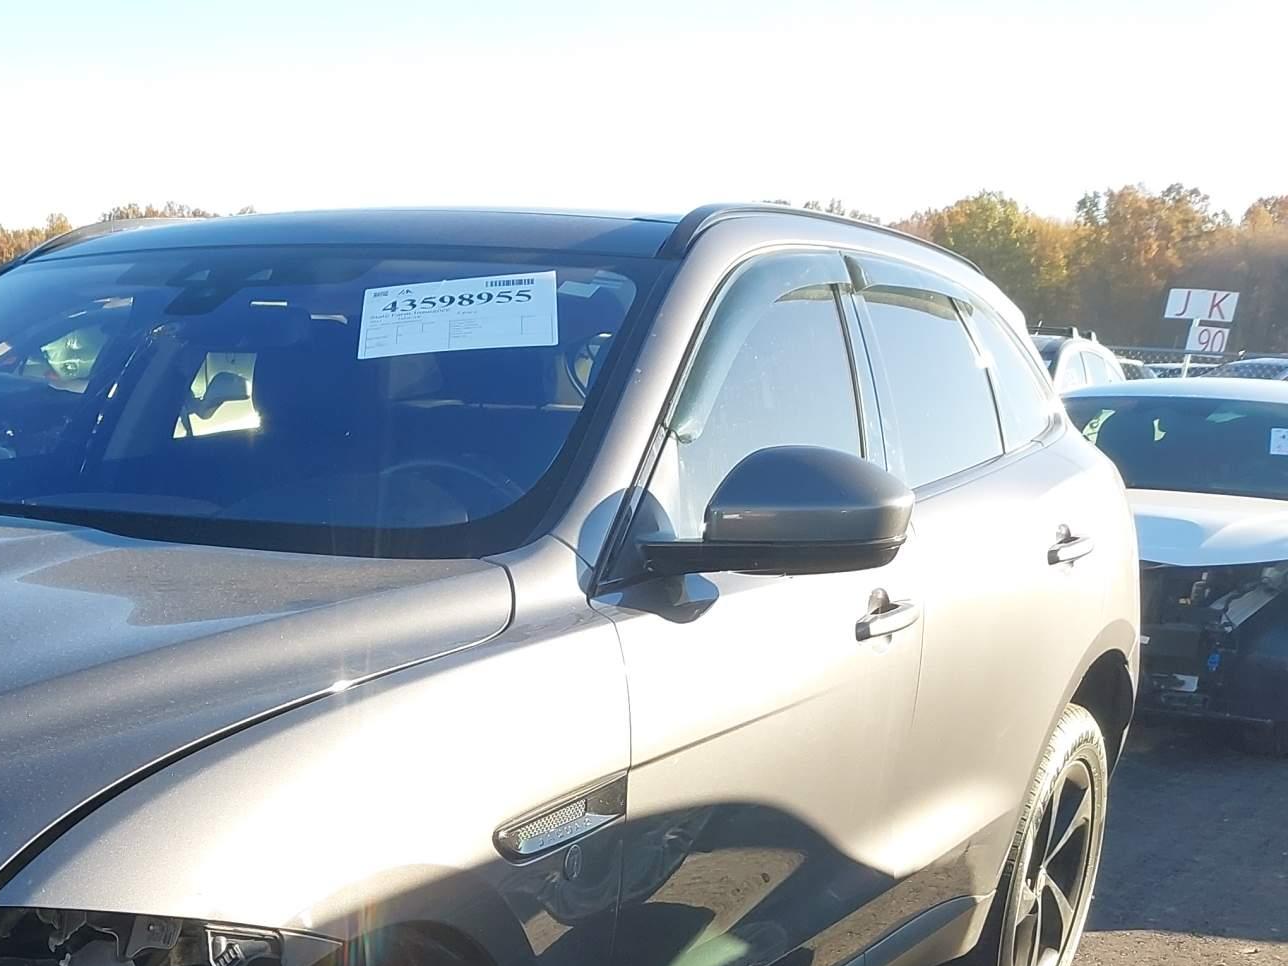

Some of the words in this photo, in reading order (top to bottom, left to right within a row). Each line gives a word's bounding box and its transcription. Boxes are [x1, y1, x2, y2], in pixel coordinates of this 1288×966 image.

[381, 288, 533, 313] 43598955
[1175, 290, 1192, 317] J
[1208, 292, 1231, 320] K
[1198, 328, 1225, 353] 90
